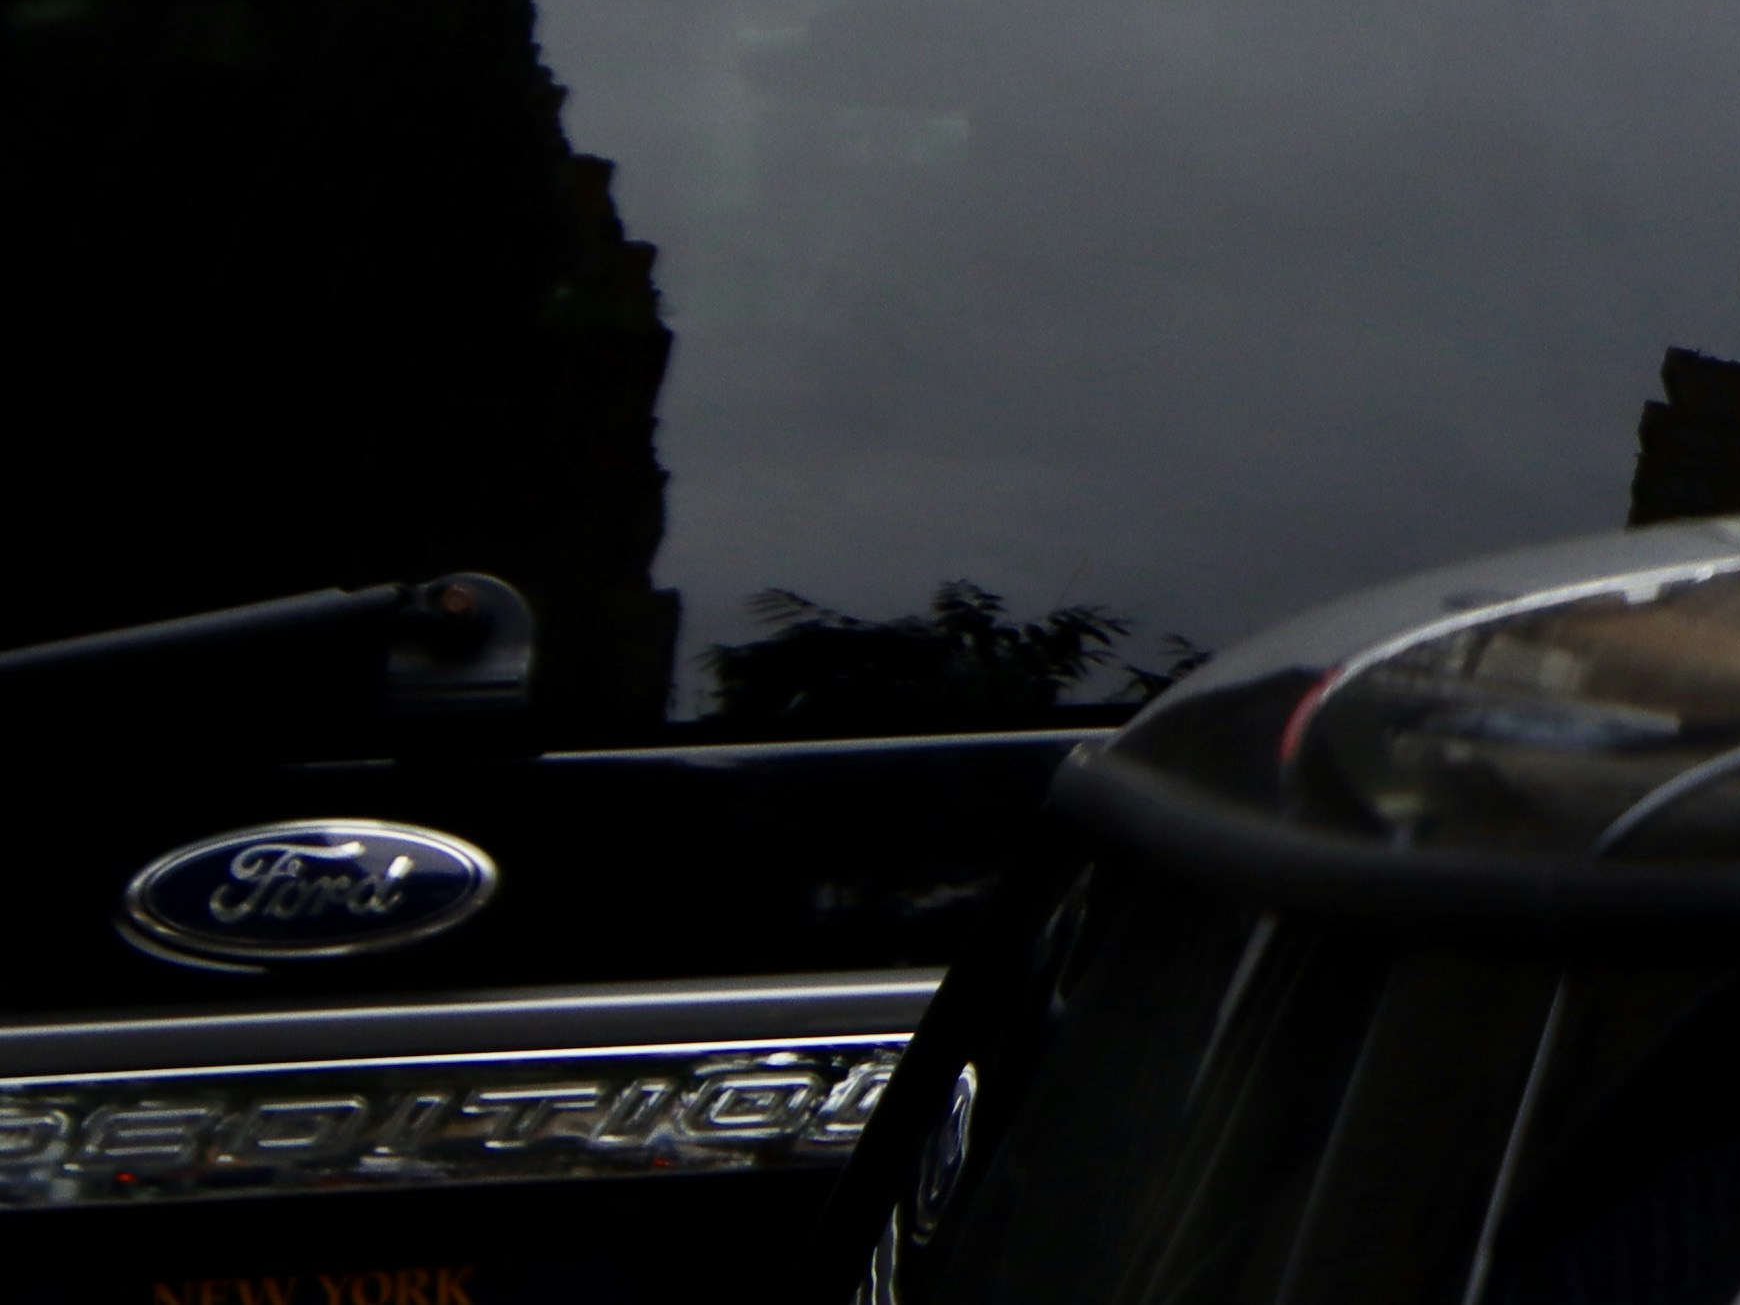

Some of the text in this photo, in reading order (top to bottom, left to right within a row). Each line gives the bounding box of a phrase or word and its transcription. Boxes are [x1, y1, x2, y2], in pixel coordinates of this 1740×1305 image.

[208, 839, 412, 923] Ford
[150, 1263, 477, 1305] NEW YORK
